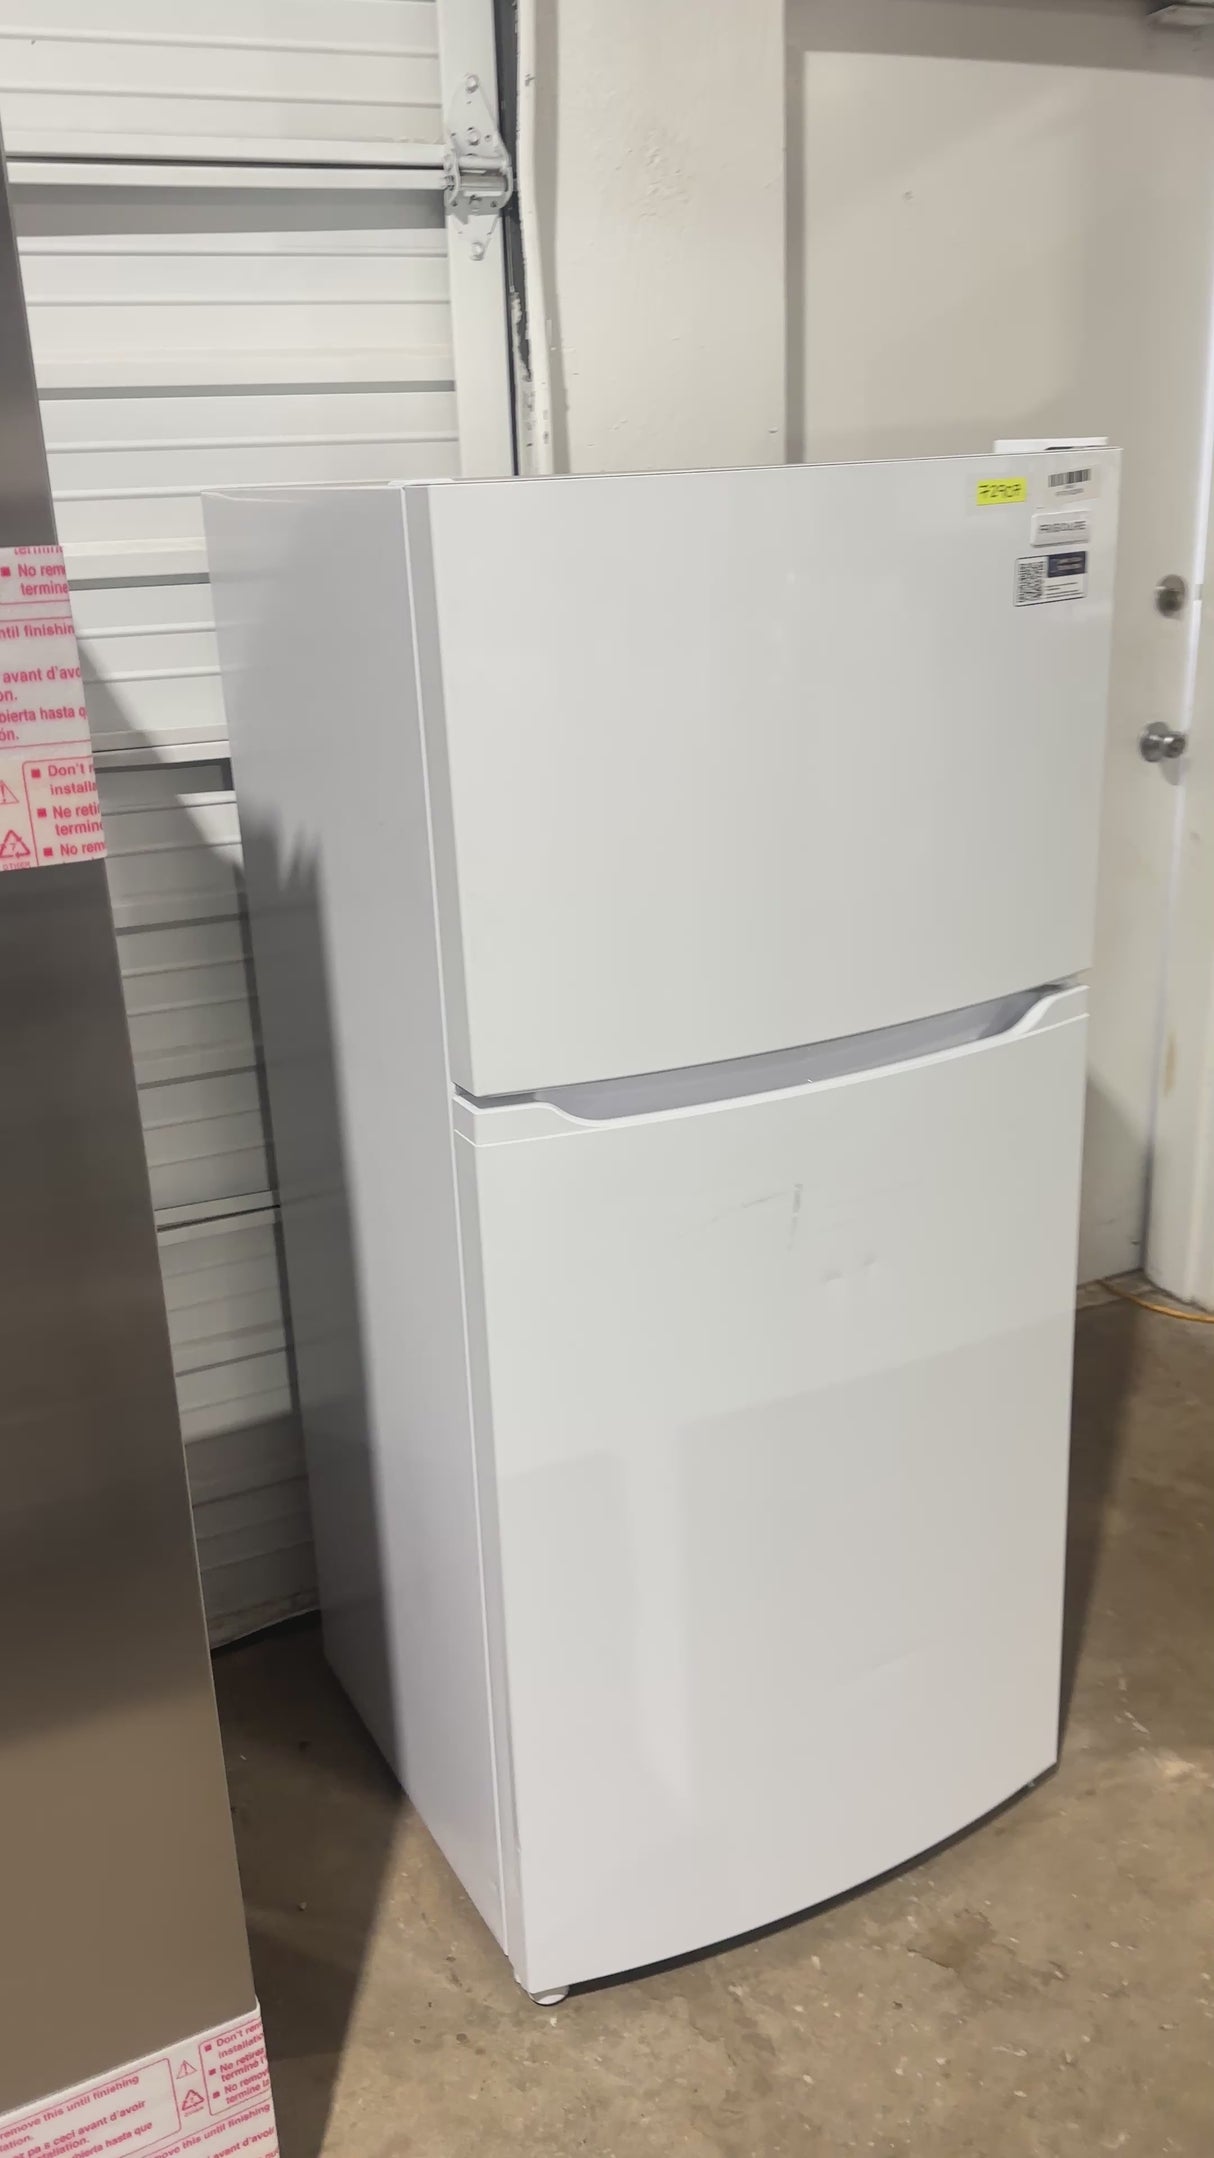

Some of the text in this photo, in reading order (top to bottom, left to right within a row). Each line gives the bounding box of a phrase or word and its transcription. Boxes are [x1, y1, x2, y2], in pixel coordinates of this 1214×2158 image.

[17, 564, 36, 577] No
[3, 668, 42, 683] avant
[40, 706, 75, 720] hasta
[47, 763, 85, 777] Don't
[52, 805, 71, 819] Ne
[60, 843, 78, 857] No
[216, 2029, 243, 2047] Don't
[221, 2060, 259, 2083] termine
[224, 2083, 238, 2095] No
[226, 2084, 261, 2104] termine
[0, 2075, 140, 2140] remove this until finishing
[53, 2129, 75, 2146] ceci
[78, 2116, 108, 2136] avant
[109, 2100, 146, 2122] d'avoir
[182, 2136, 201, 2150] this
[204, 2122, 226, 2140] until
[228, 2103, 271, 2128] finishing
[105, 2131, 132, 2148] hasta
[134, 2121, 152, 2137] que
